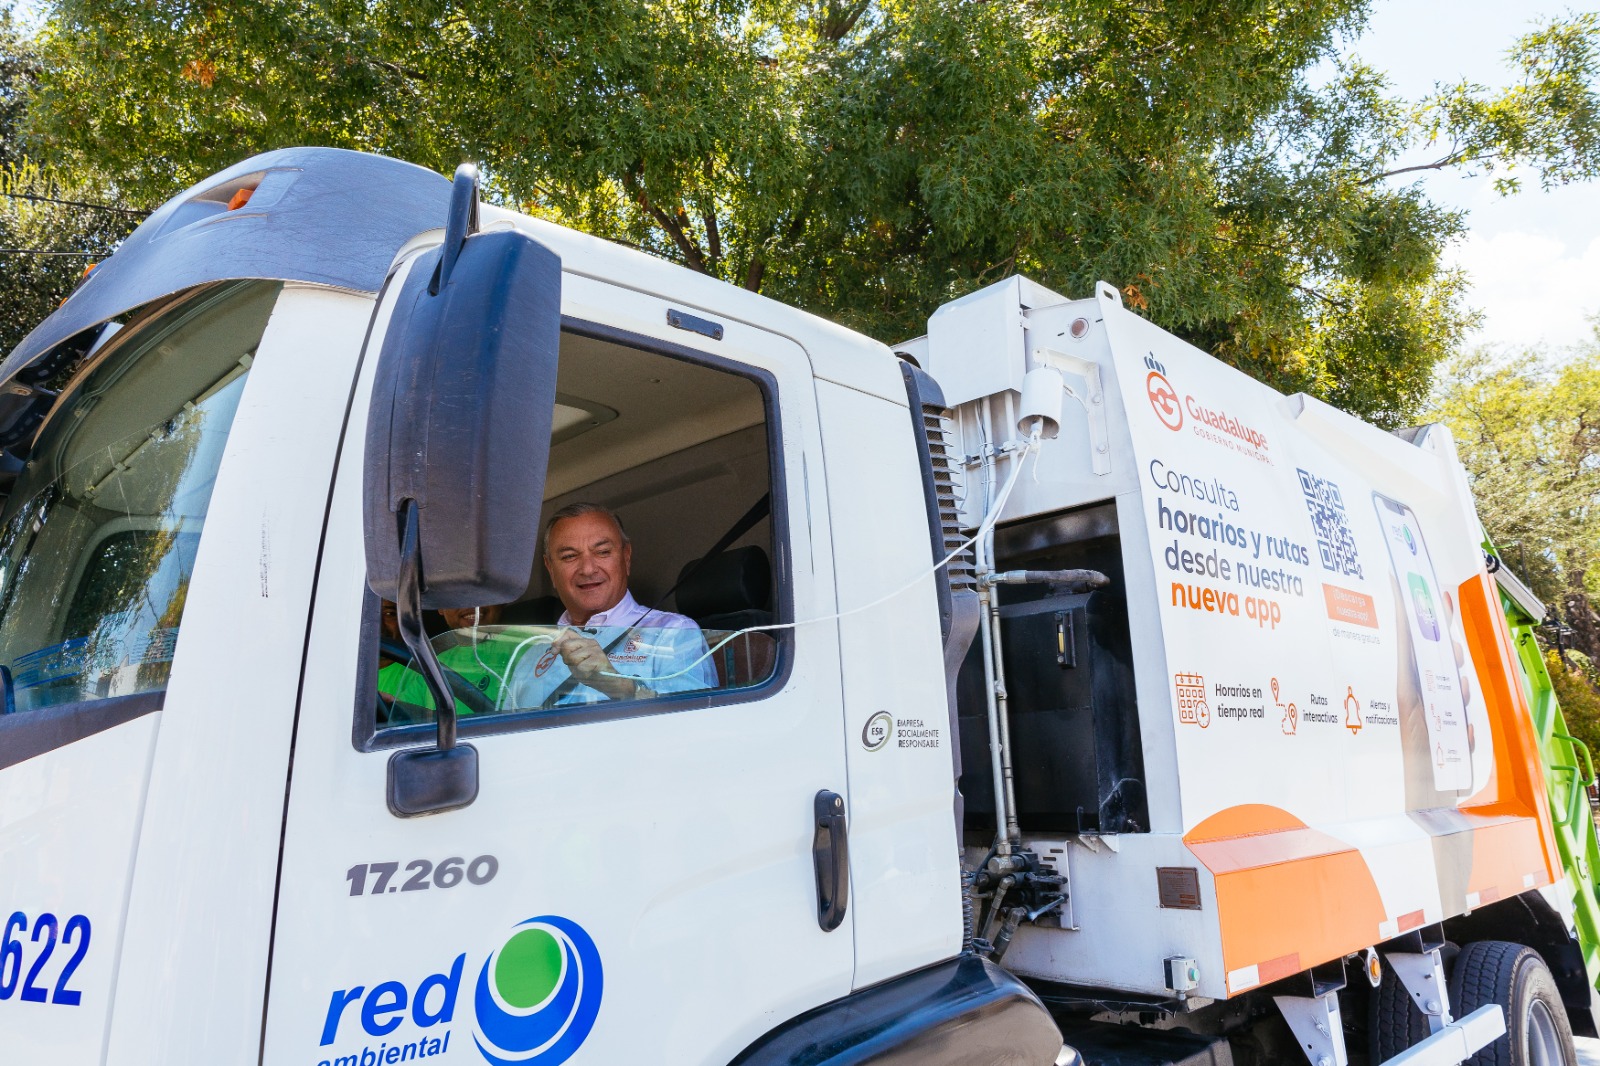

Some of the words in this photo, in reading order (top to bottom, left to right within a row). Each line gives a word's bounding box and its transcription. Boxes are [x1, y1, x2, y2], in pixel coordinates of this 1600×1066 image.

[1185, 395, 1268, 450] Guadalupe
[1193, 425, 1234, 450] GOBIERNO
[1236, 443, 1275, 467] MUNICIPAL
[1150, 459, 1239, 512] Consulta
[1158, 497, 1247, 549] horarios
[1250, 531, 1261, 559] y
[1266, 535, 1309, 566] rutas
[1165, 540, 1231, 581] desde
[1237, 560, 1304, 597] nuestra
[1171, 581, 1240, 617] nueva
[1245, 596, 1281, 630] app
[1215, 683, 1250, 698] Horarios
[1252, 688, 1262, 698] en
[1310, 693, 1328, 706] Rutas
[1217, 703, 1247, 721] tiempo
[1249, 705, 1264, 718] real
[1370, 699, 1387, 711] Alertas
[897, 719, 924, 728] EMPRESA
[1303, 709, 1338, 724] interactivas
[1365, 714, 1398, 725] notificaciones
[871, 727, 884, 736] ESR
[897, 729, 939, 738] SOCIALMENTE
[898, 739, 939, 748] RESPONSABLE
[346, 854, 499, 897] 17.260
[0, 910, 91, 1006] 622
[319, 952, 466, 1047] red
